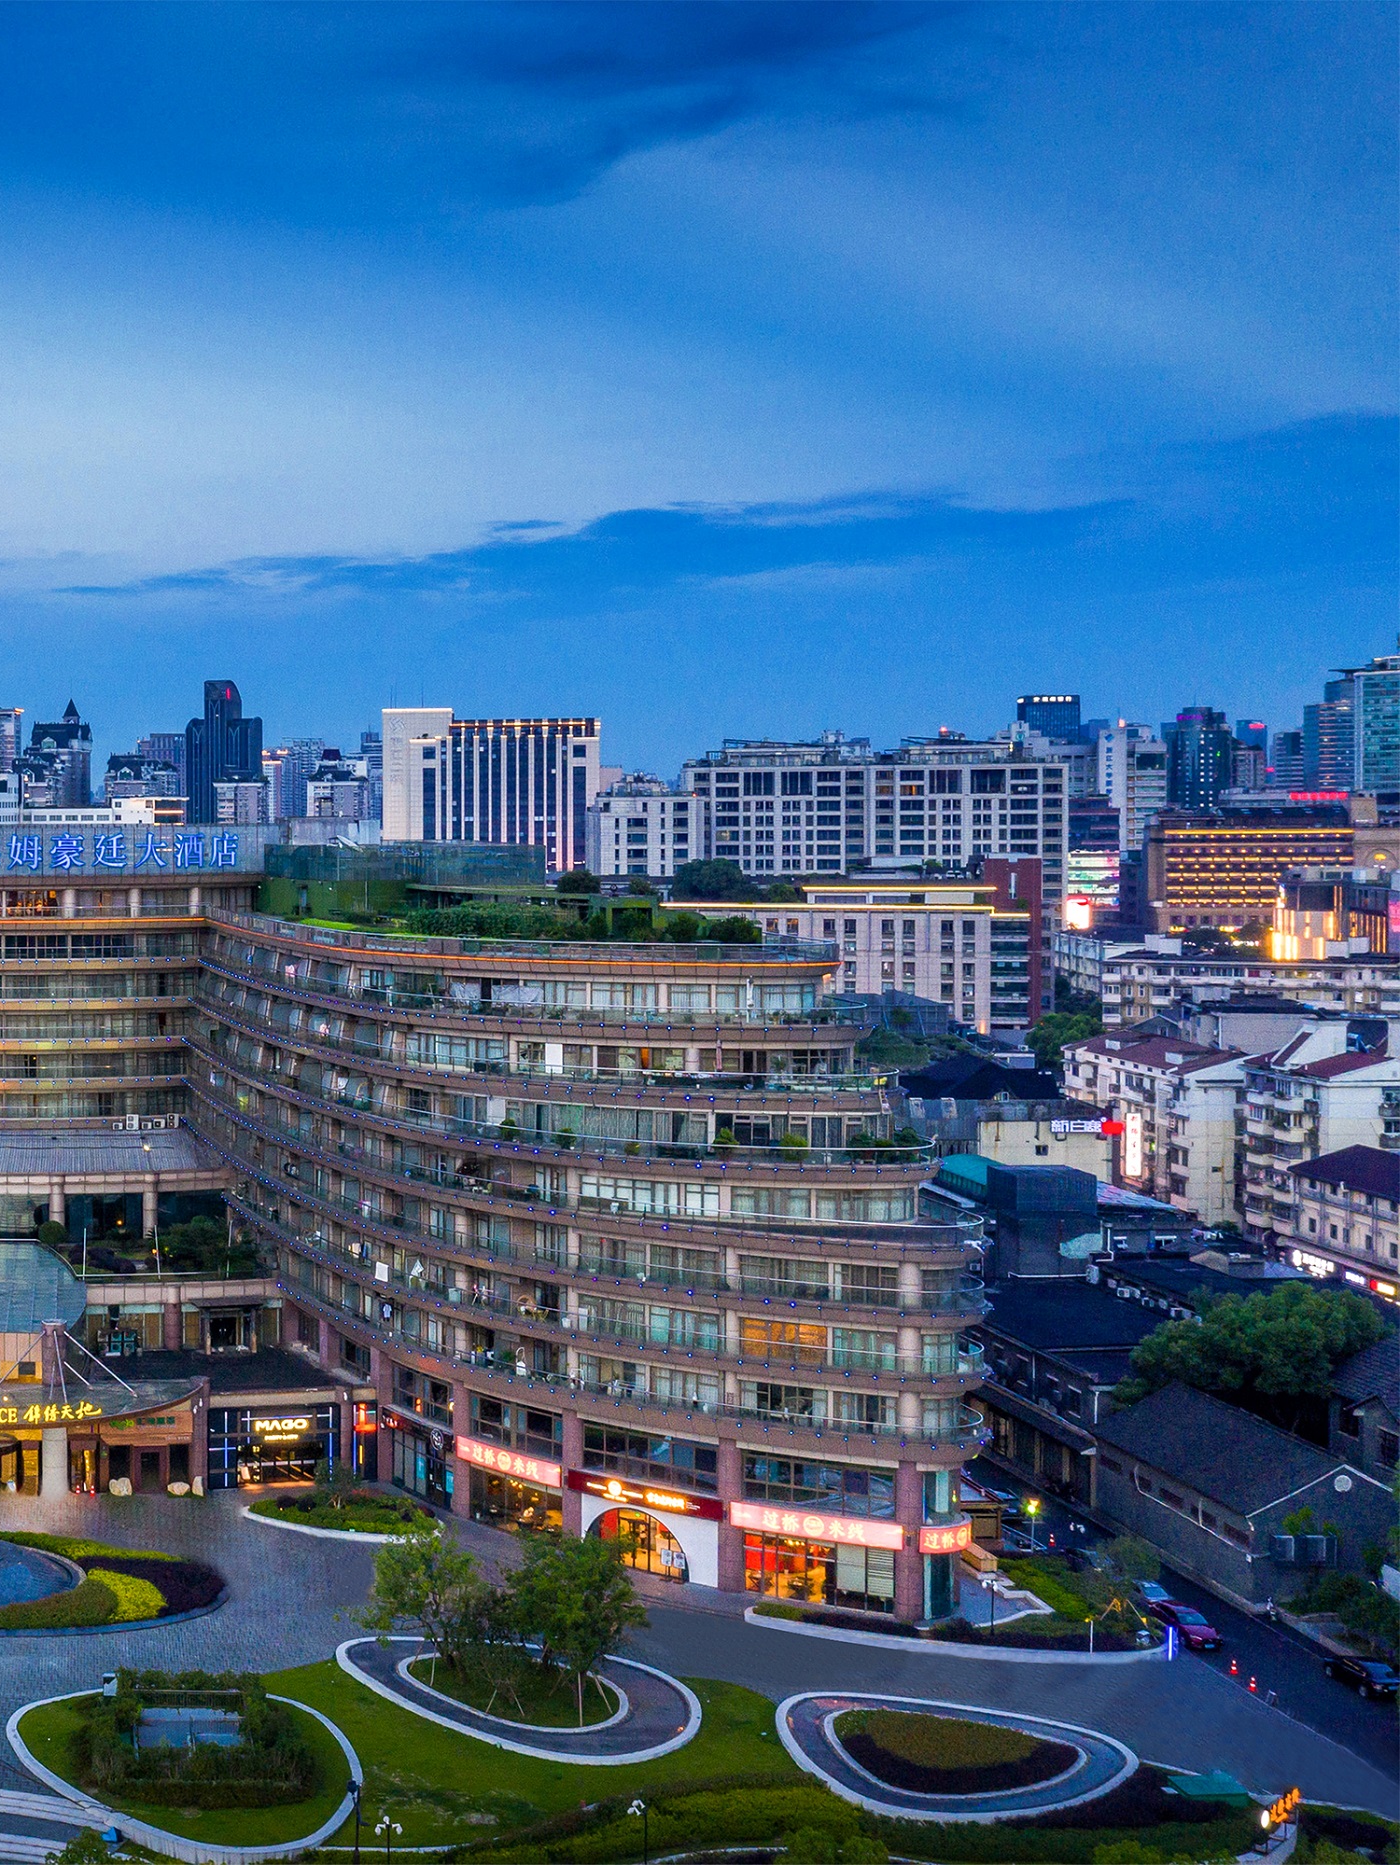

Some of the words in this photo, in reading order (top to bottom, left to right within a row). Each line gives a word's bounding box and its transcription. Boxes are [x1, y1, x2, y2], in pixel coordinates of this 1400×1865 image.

[255, 1418, 308, 1432] MAGO
[762, 1511, 799, 1533] 过桥
[828, 1520, 866, 1543] 米线
[924, 1532, 955, 1549] 过桥
